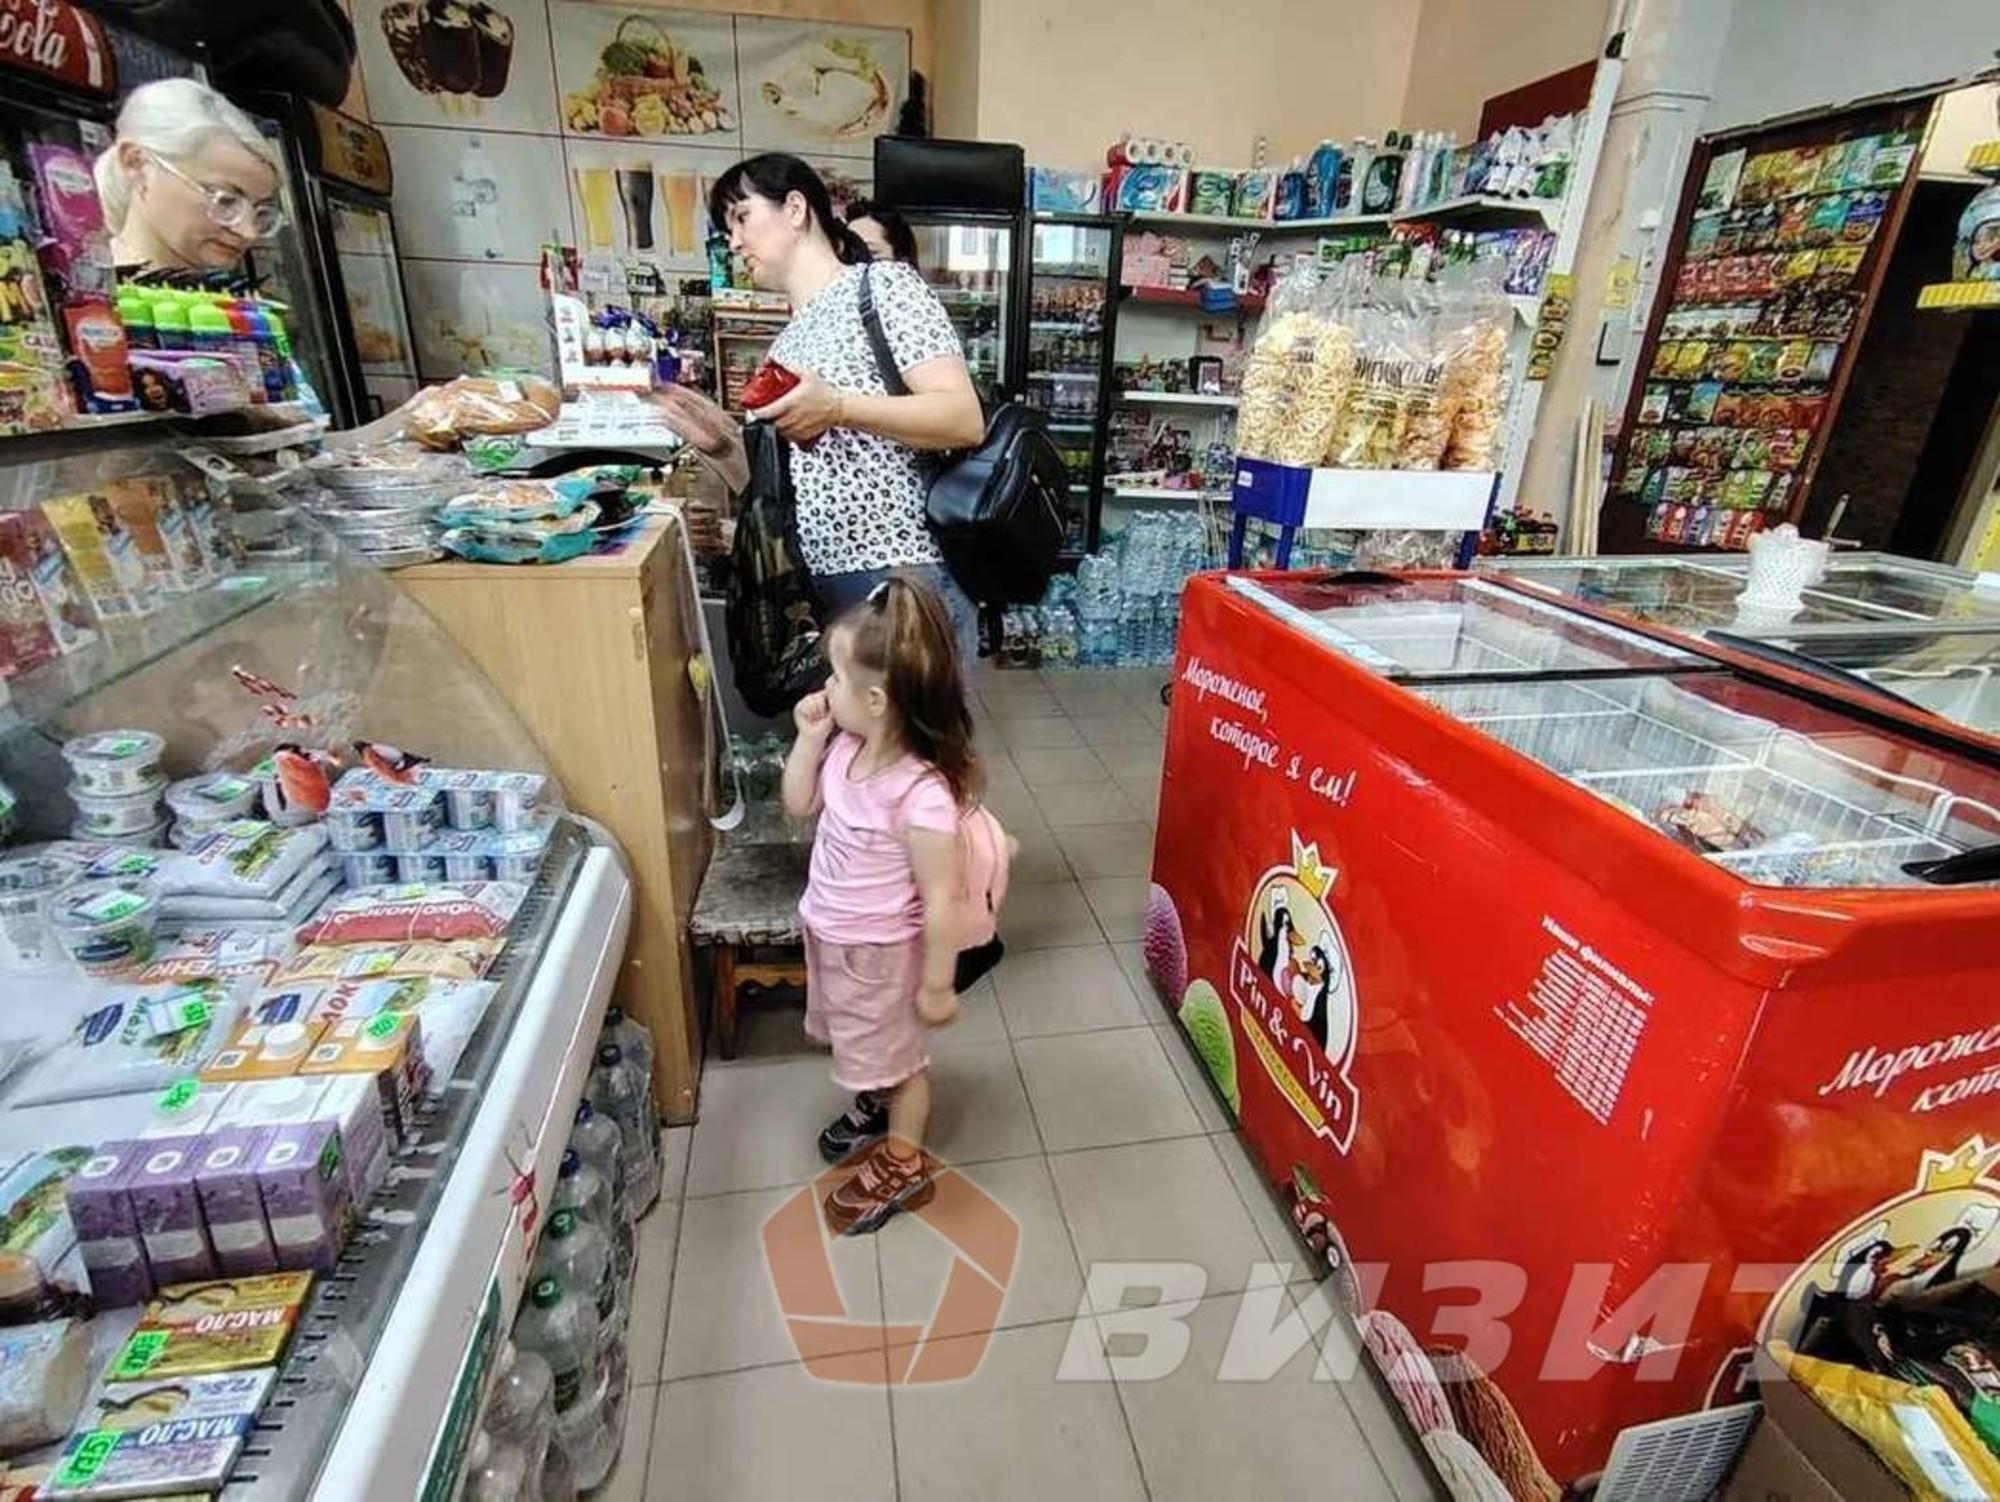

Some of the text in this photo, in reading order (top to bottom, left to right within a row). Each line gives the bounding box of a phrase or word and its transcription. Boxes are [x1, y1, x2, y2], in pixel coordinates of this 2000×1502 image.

[1210, 716, 1358, 807] которое я ем!
[1240, 957, 1344, 1121] Pin & Vin
[196, 1308, 286, 1332] МАСЛО
[138, 1416, 240, 1445] МАСЛО
